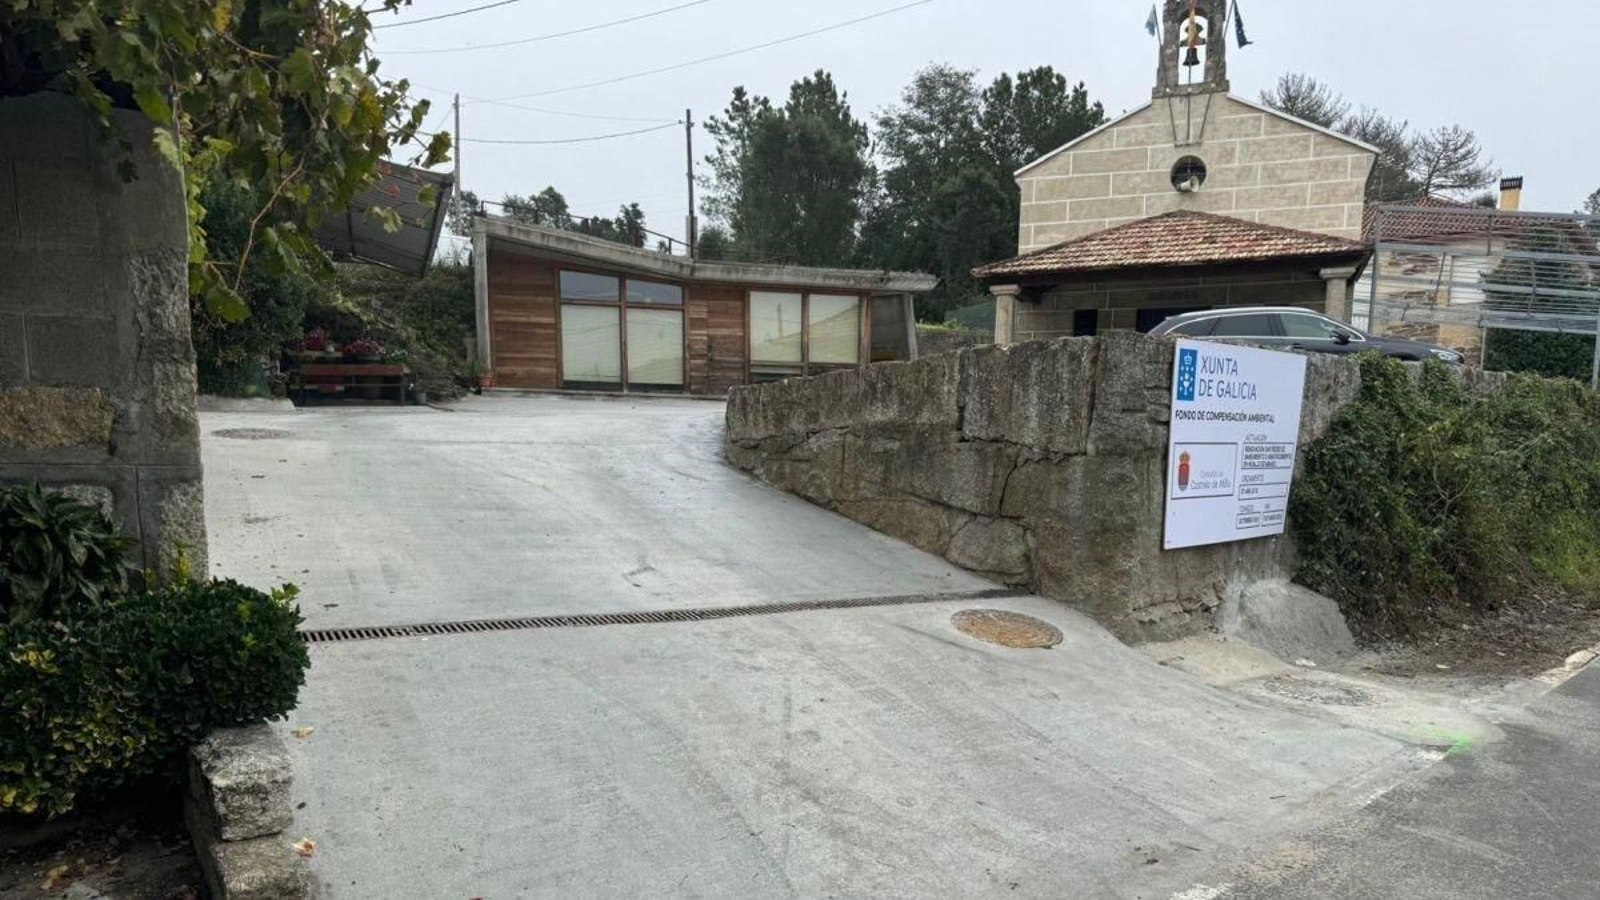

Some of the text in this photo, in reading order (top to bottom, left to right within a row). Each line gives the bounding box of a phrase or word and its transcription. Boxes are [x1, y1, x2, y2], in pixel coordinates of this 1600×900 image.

[1200, 355, 1238, 375] XUNTA
[1199, 379, 1257, 400] DE GALICIA
[1175, 410, 1275, 424] FONDO DE COMPENSACIÓN AMBIENTAL
